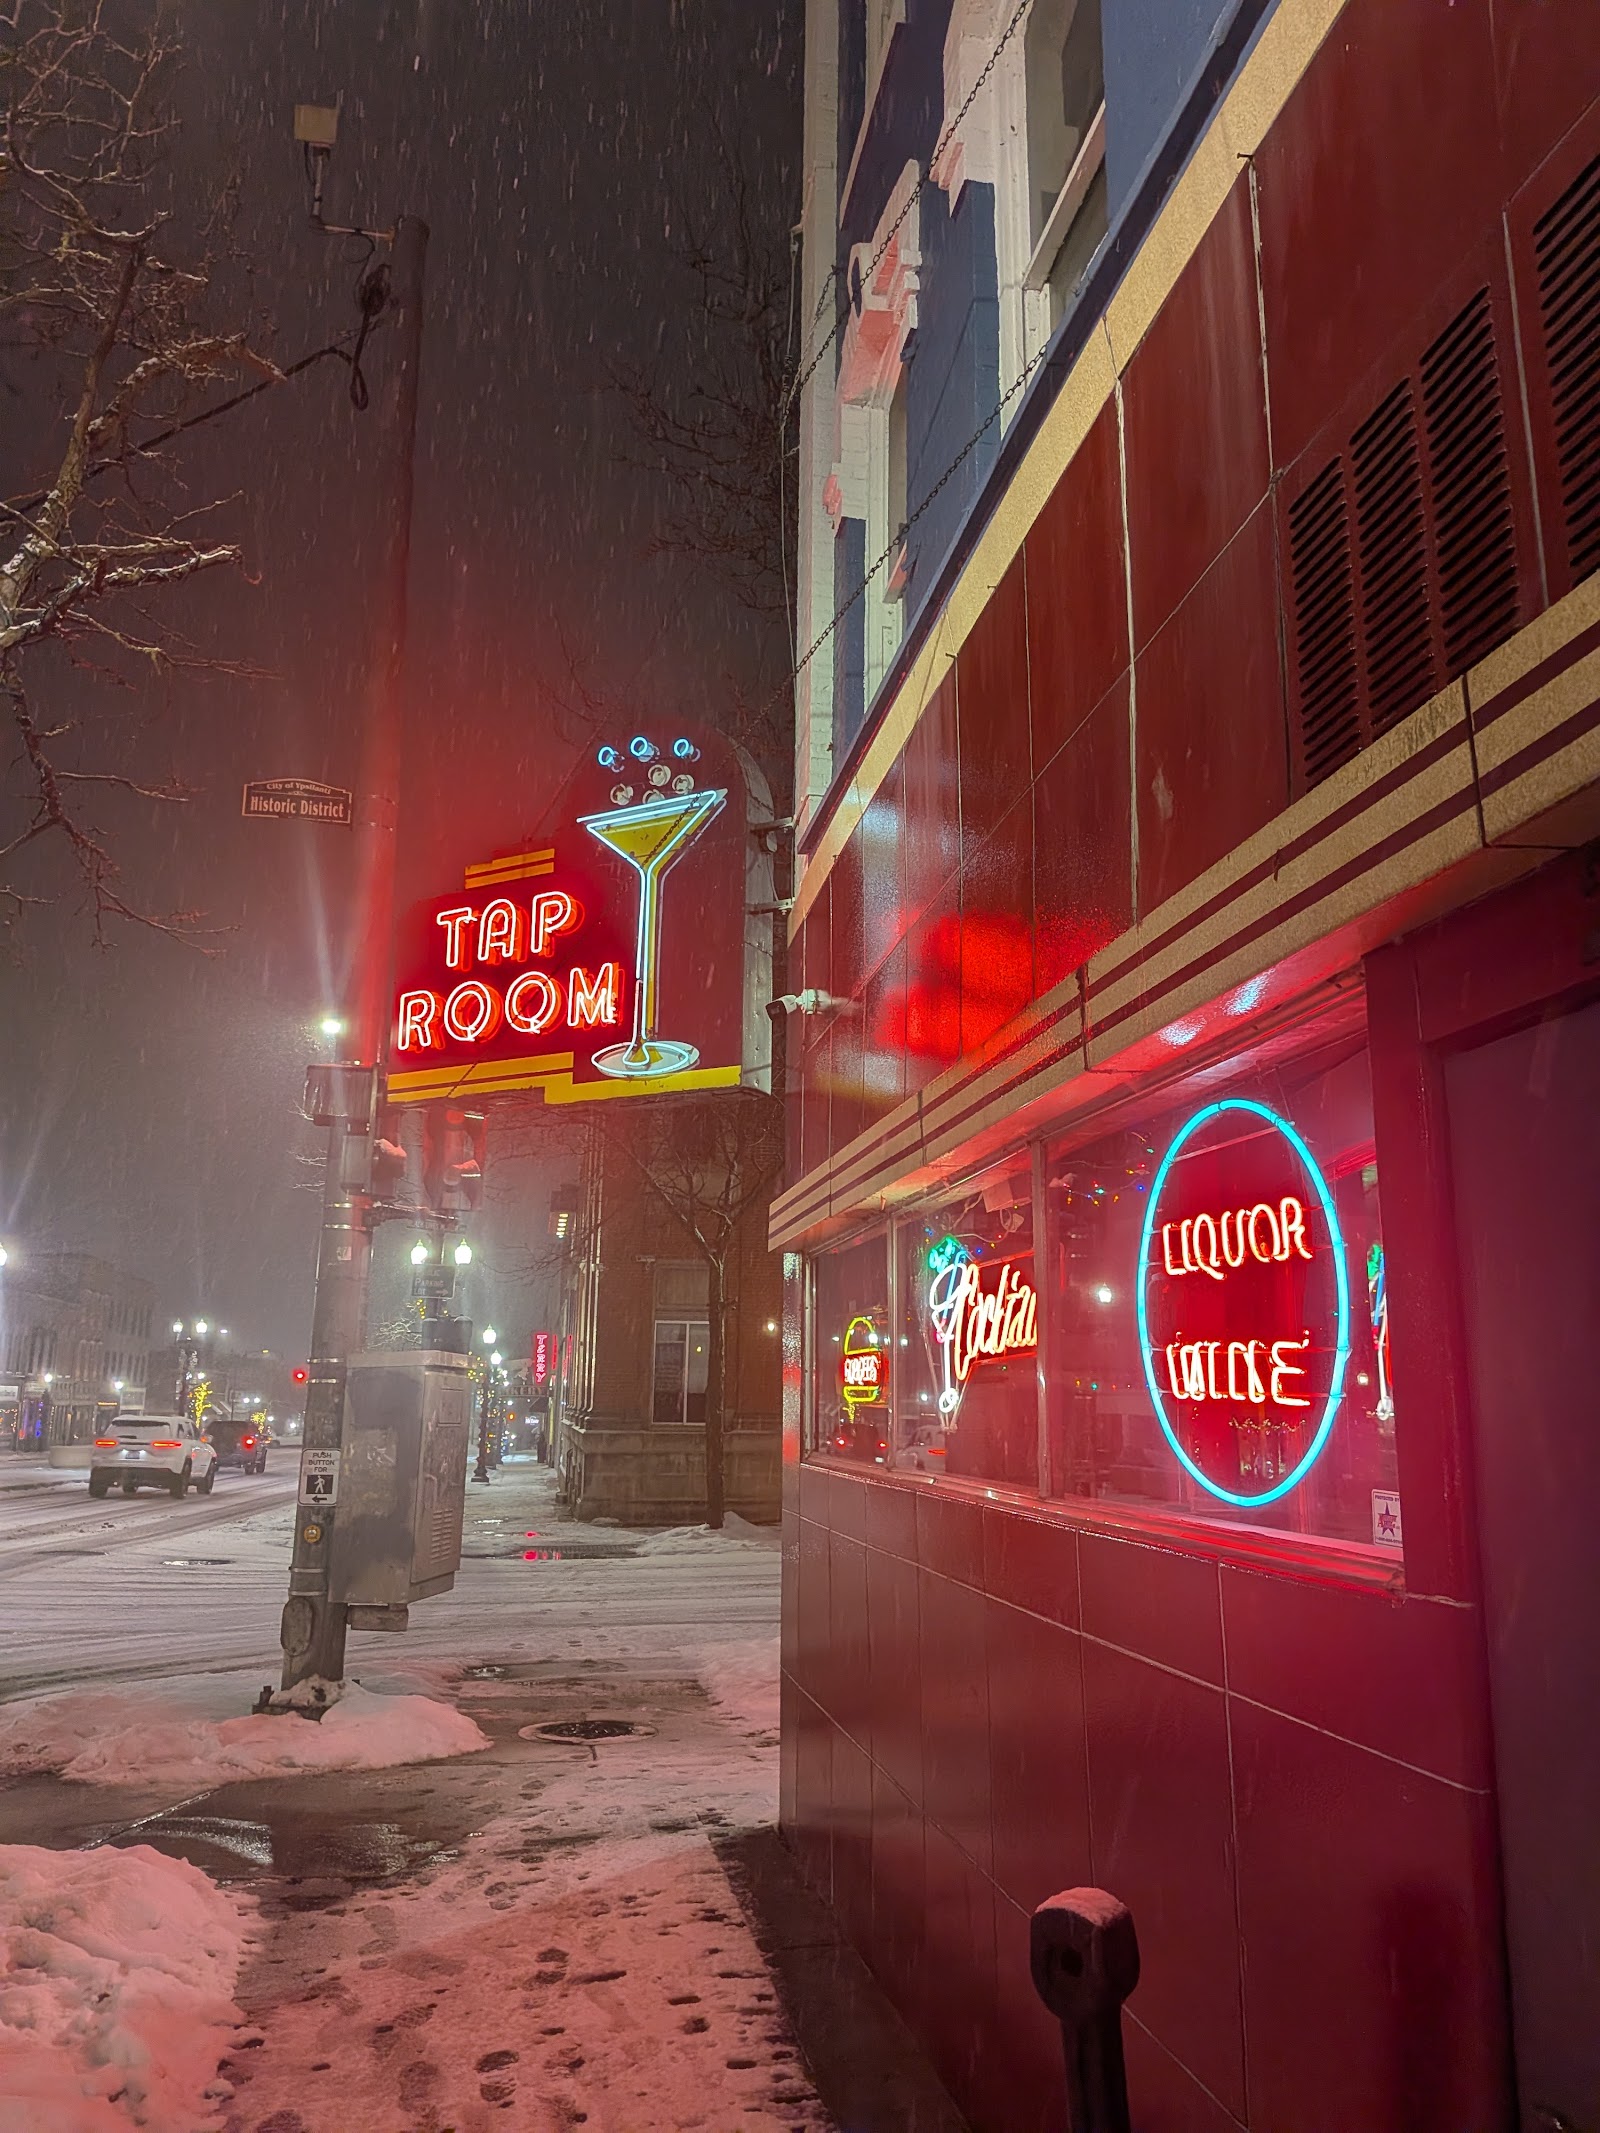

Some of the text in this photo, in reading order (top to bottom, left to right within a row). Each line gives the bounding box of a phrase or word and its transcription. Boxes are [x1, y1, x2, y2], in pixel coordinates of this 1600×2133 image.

[250, 795, 344, 818] Historic District
[266, 782, 283, 791] City
[295, 782, 332, 795] Ypsilanti
[437, 891, 578, 970] TAP
[398, 963, 622, 1051] ROOM
[1162, 1197, 1312, 1280] LIQUOR
[1165, 1335, 1311, 1406] WINE
